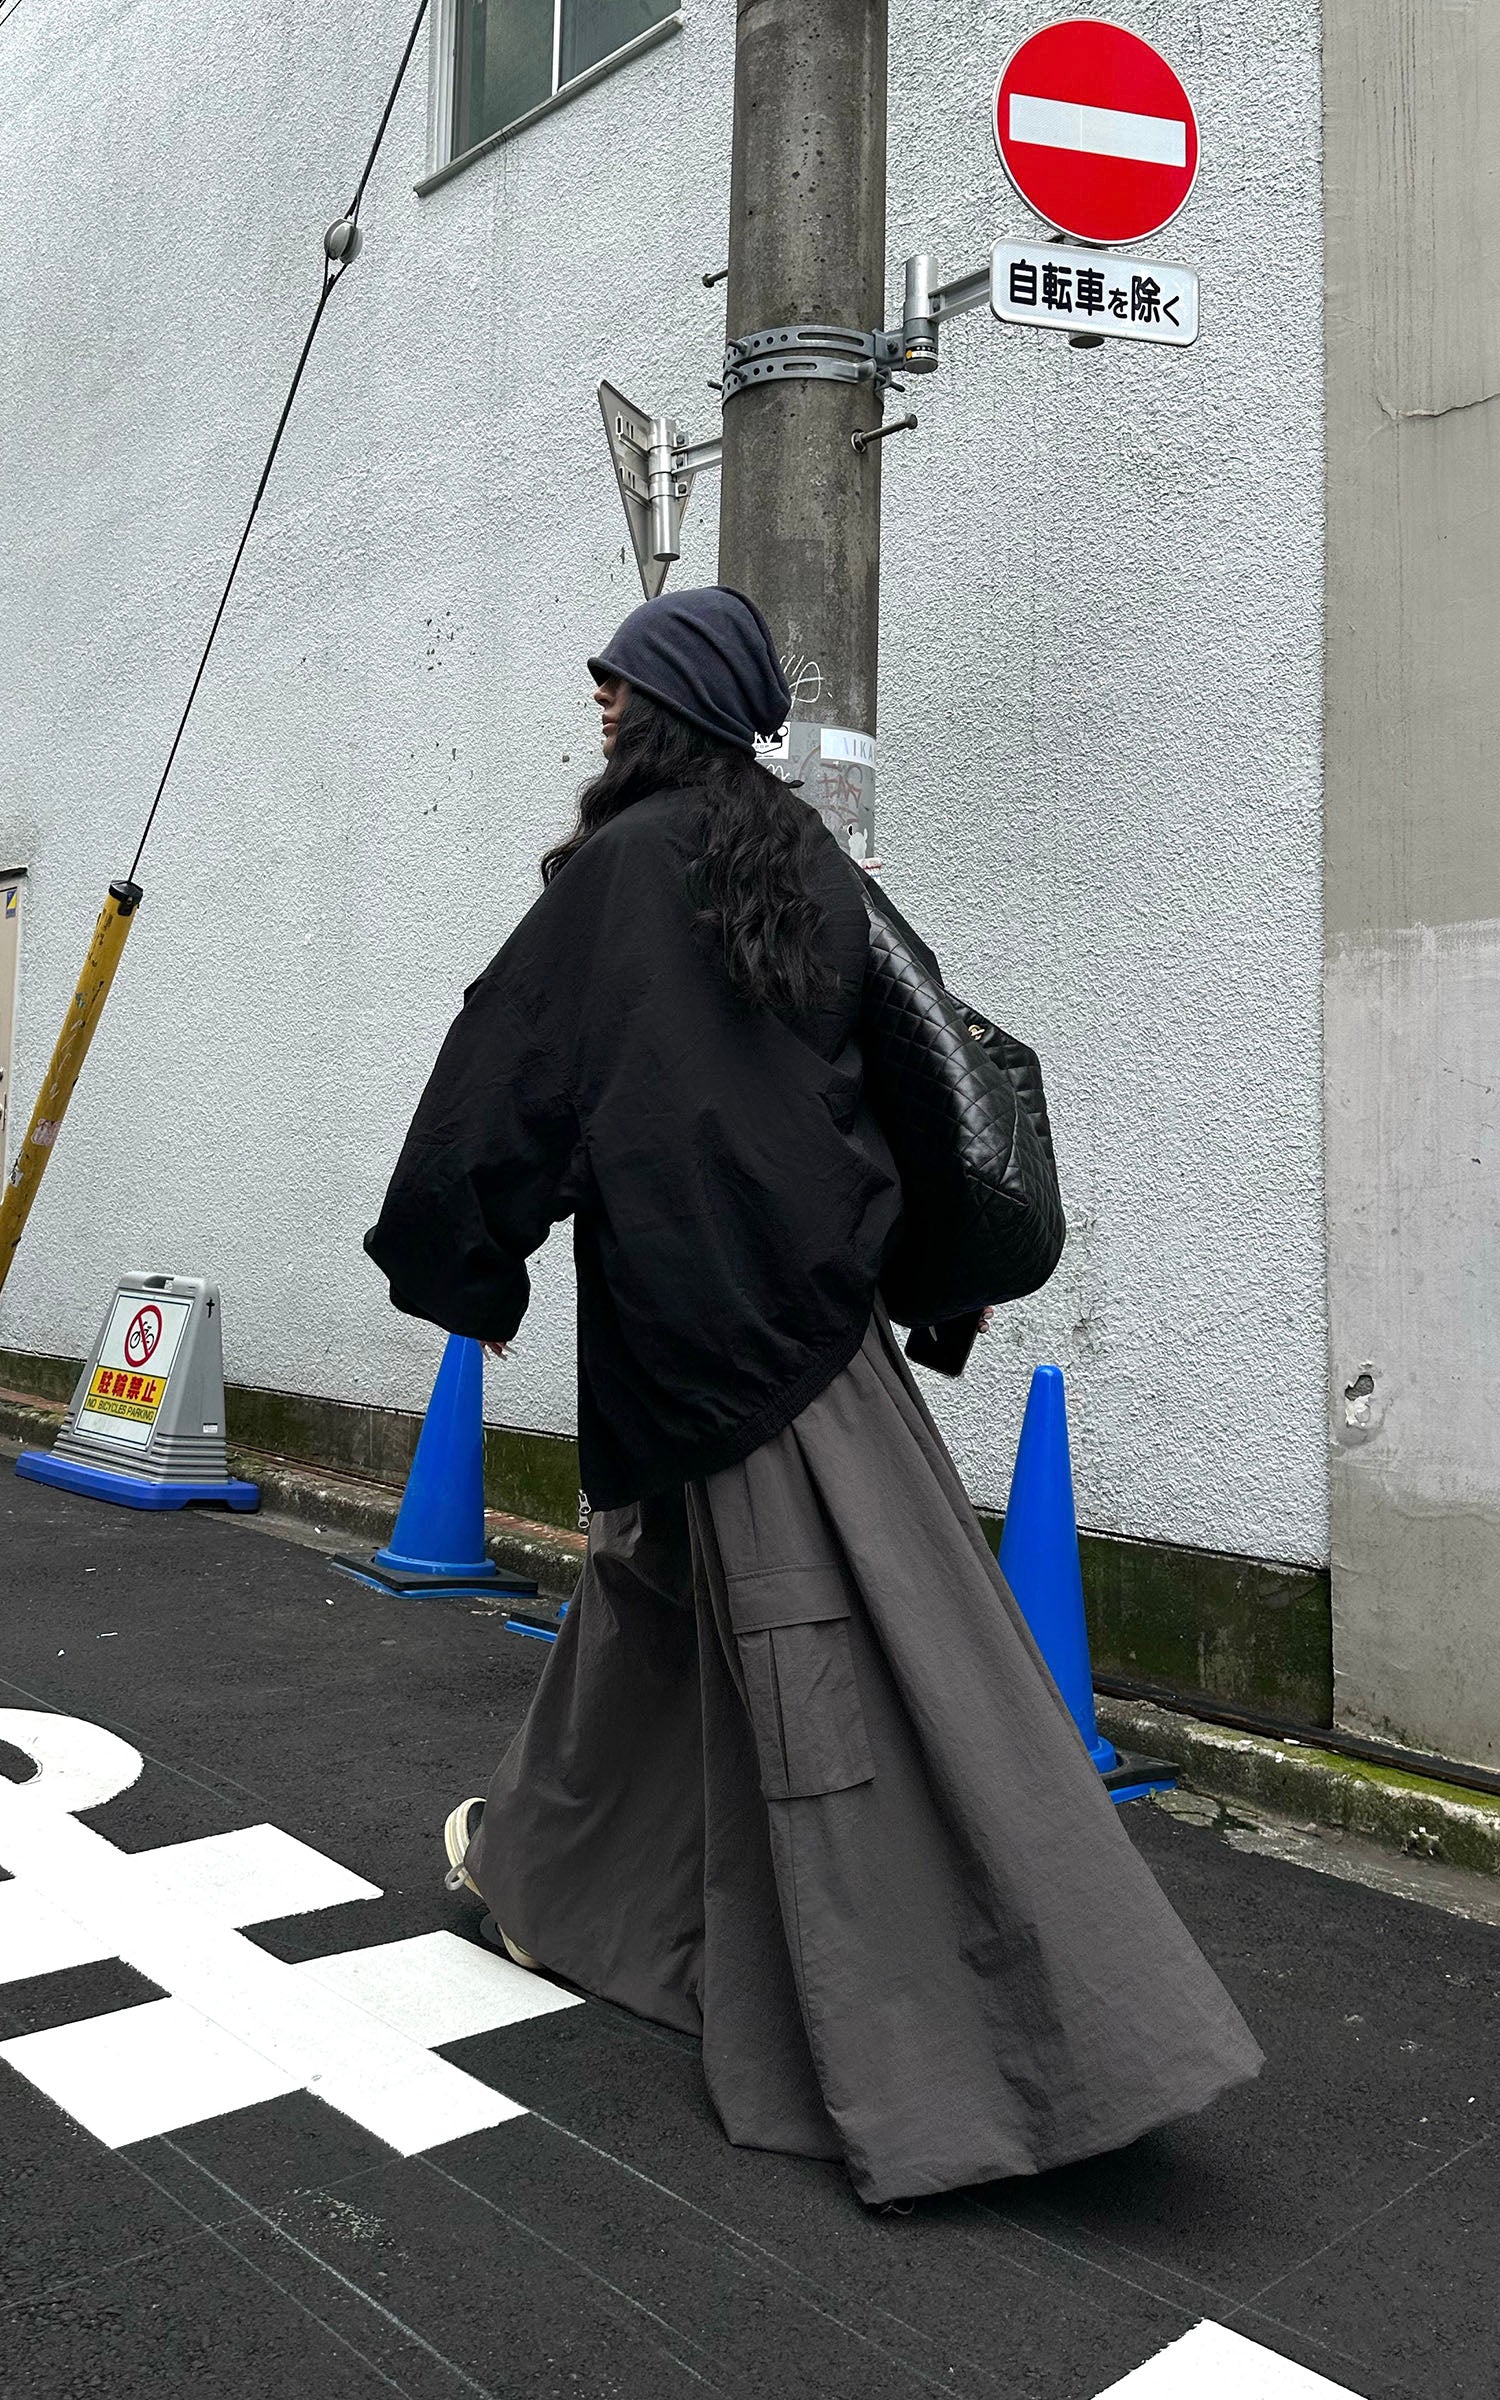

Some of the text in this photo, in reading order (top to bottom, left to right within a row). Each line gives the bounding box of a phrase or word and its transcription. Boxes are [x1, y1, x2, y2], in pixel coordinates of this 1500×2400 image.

[1009, 258, 1180, 327] 自転車を除く
[97, 1370, 157, 1403] 駐輪禁止
[86, 1397, 155, 1421] NO BICYCLES PARKING
